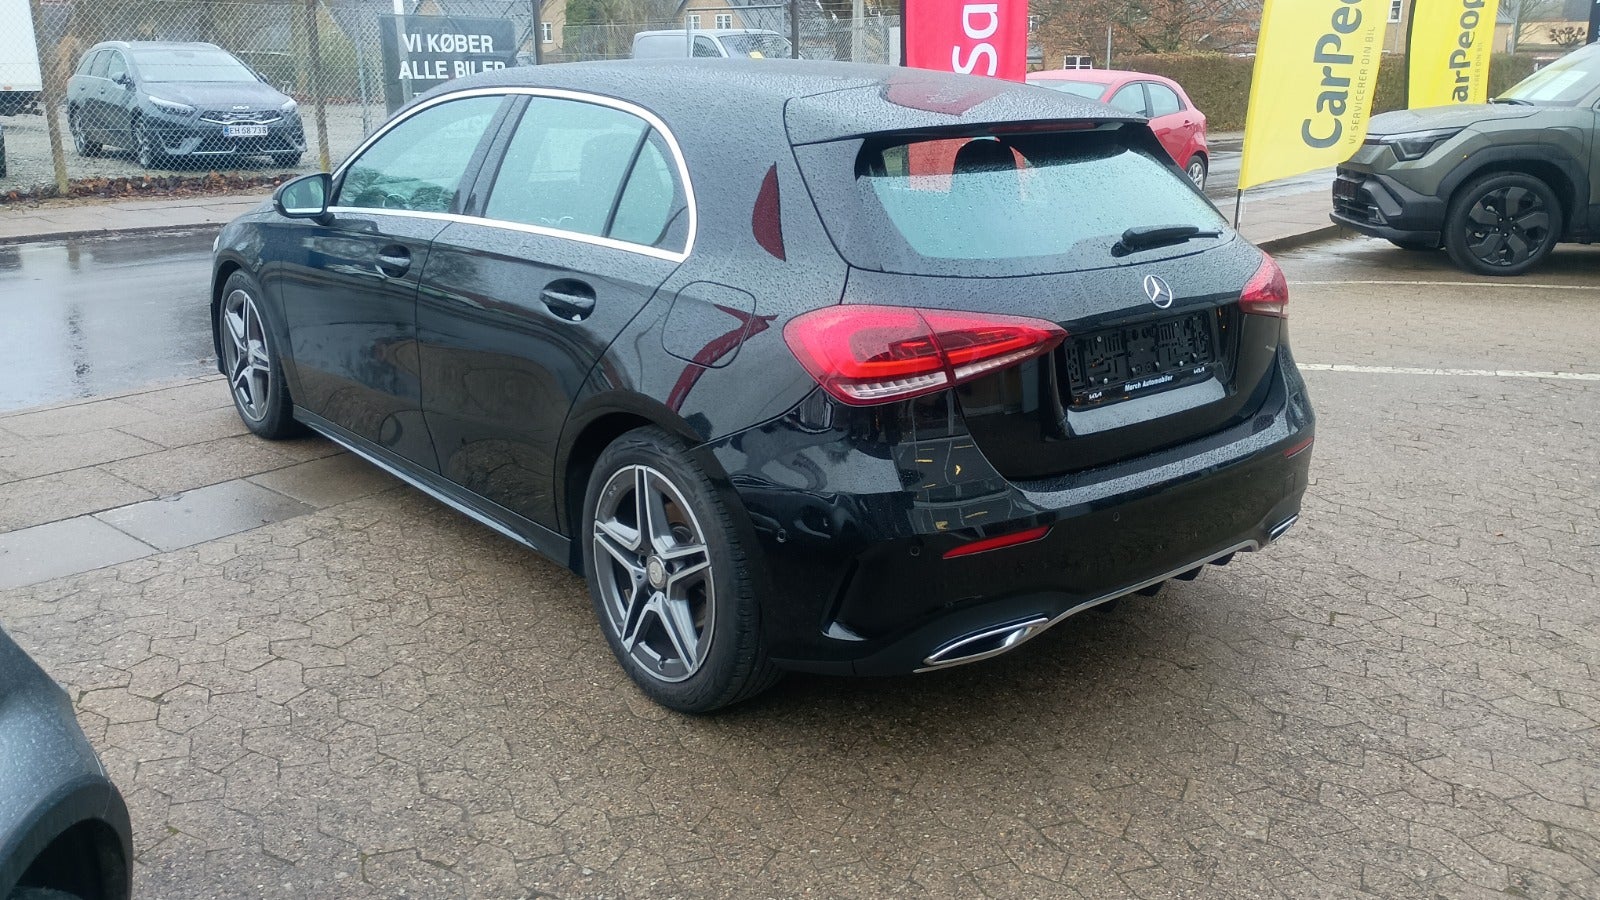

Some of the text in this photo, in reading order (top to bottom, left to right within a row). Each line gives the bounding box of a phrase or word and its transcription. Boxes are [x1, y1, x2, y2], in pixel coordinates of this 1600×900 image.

[398, 60, 449, 80] ALLE
[402, 33, 493, 53] VI KØBER
[1301, 0, 1363, 149] CarPe
[1348, 26, 1376, 145] VI SERVICERER DIN BIL
